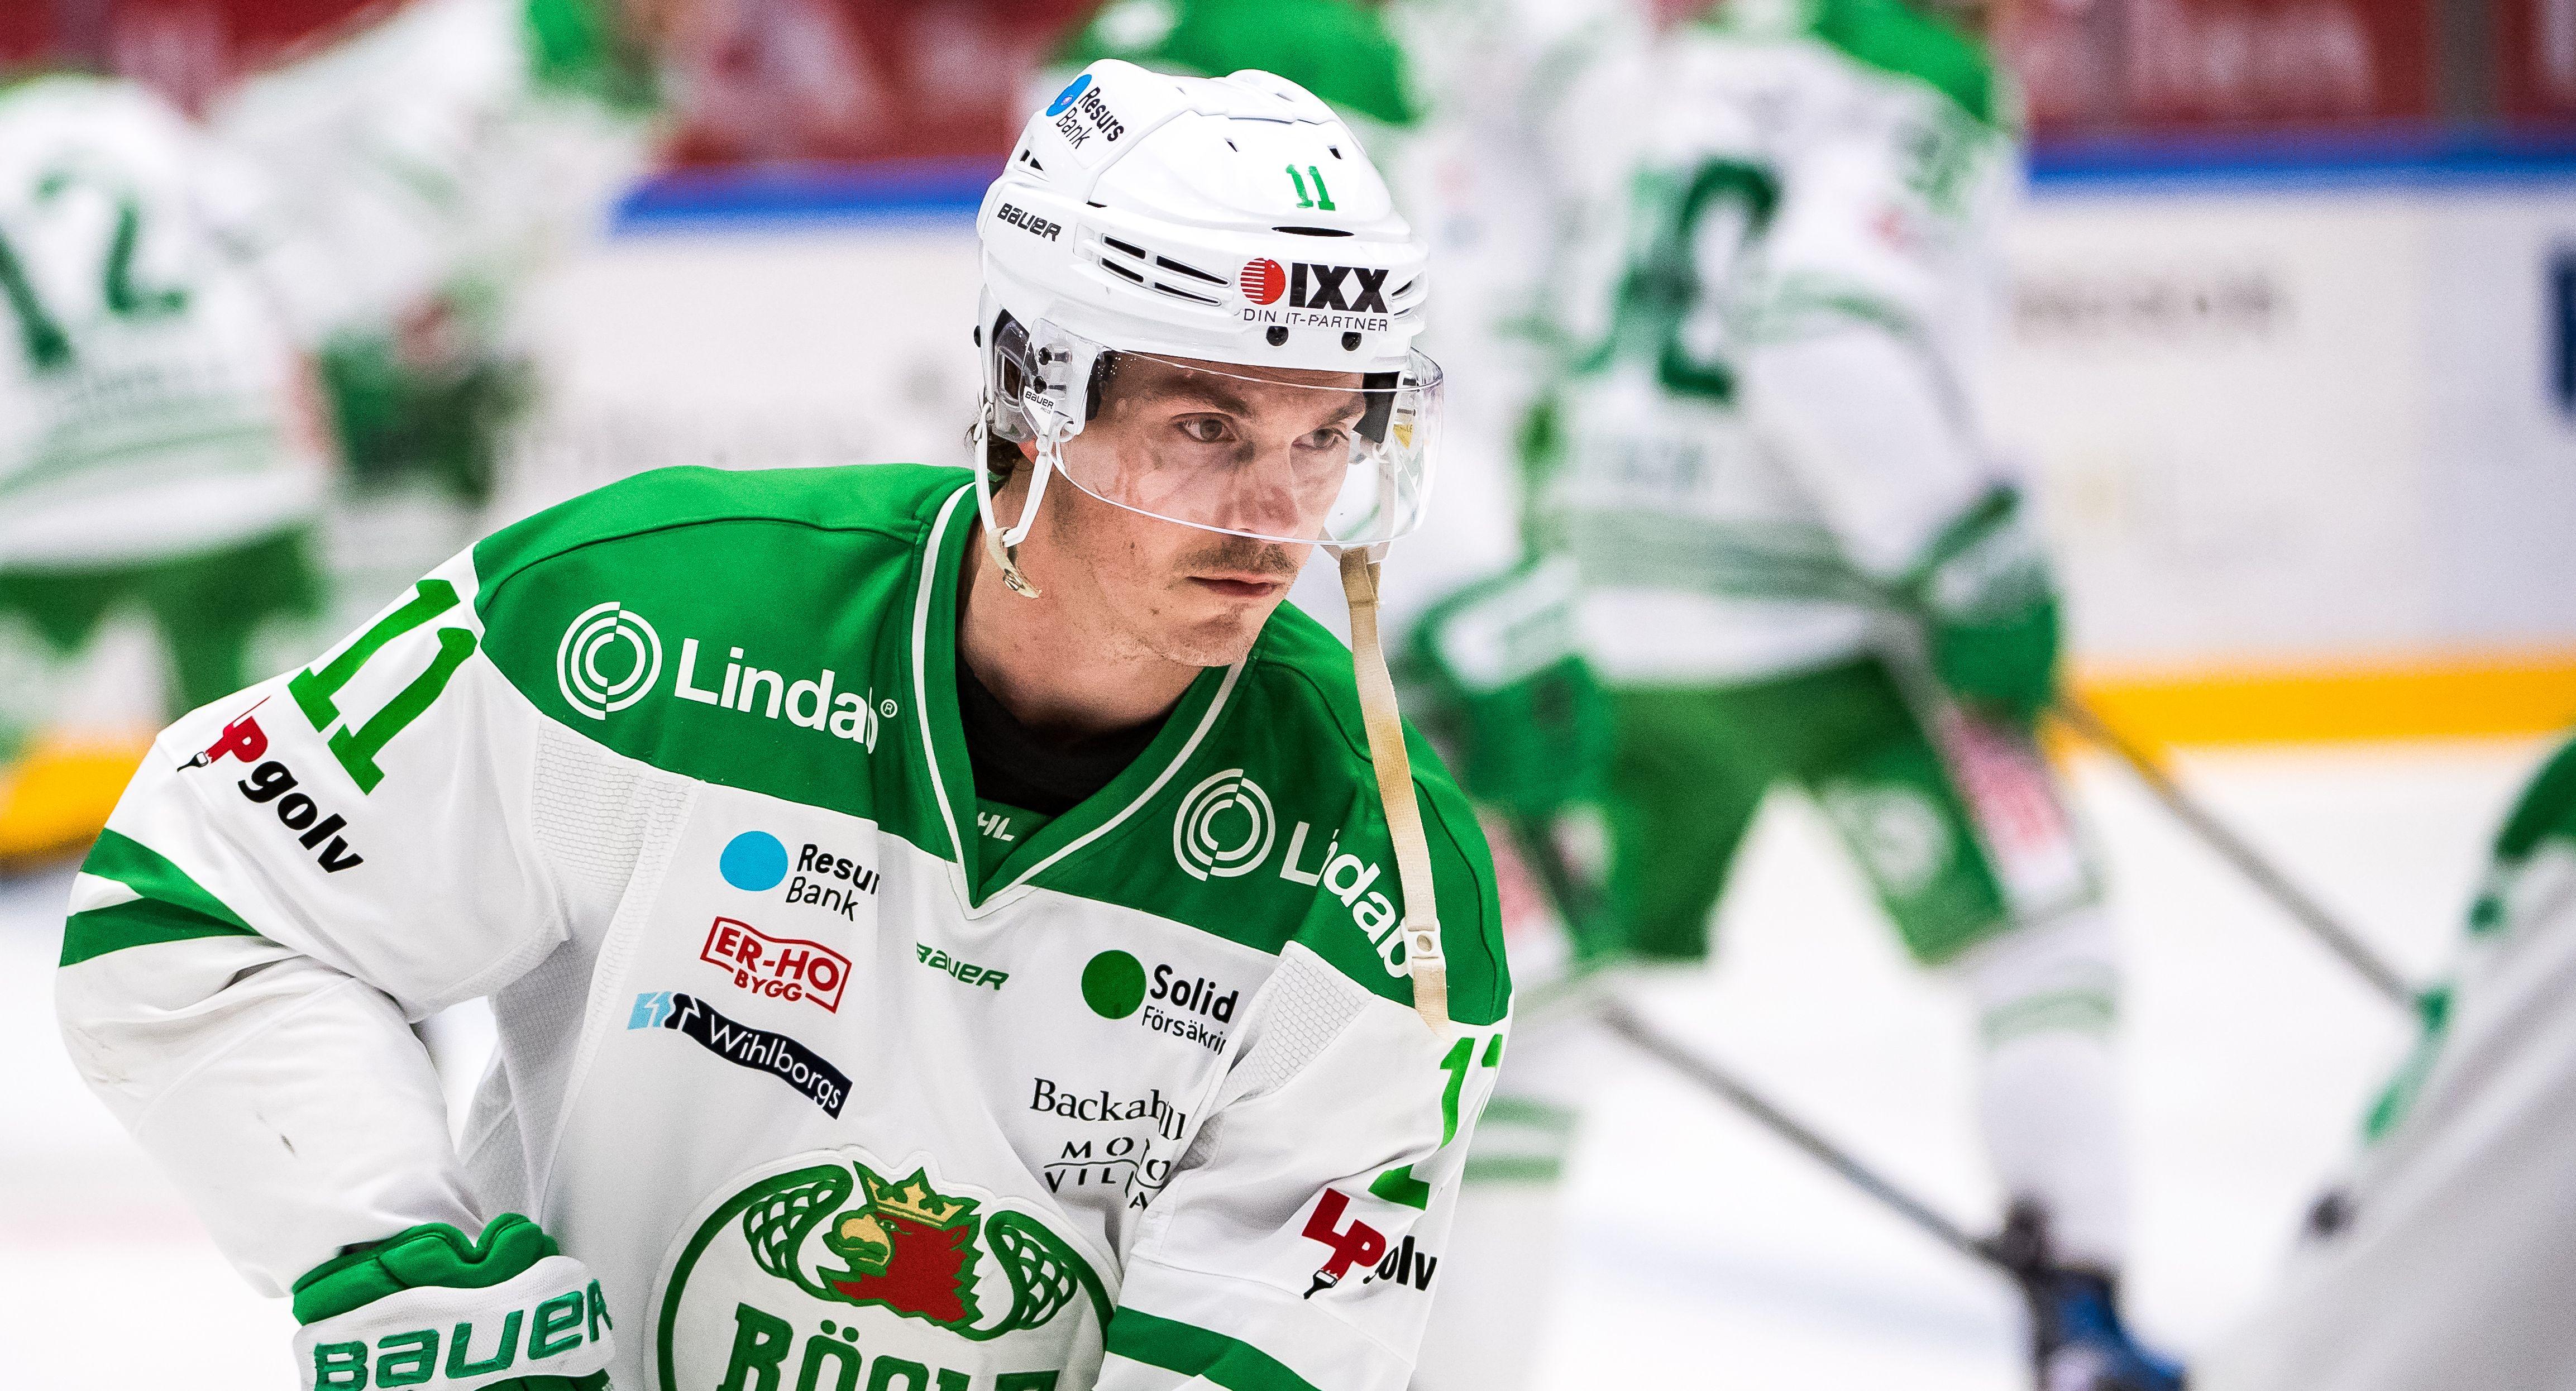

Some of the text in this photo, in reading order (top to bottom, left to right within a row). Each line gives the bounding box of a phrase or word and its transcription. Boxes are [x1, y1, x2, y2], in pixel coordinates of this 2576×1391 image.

[1056, 107, 1092, 149] Bank
[1078, 87, 1124, 142] Resurs
[1285, 164, 1336, 211] 11
[1289, 262, 1389, 313] IXX
[1244, 308, 1388, 332] DIN IT-PARTNER
[288, 579, 477, 796] 11
[206, 696, 364, 873] P golv
[797, 844, 880, 895] Resur
[786, 876, 858, 921] Bank
[715, 926, 839, 992] ER-HO
[734, 968, 802, 1001] BYGG
[1150, 964, 1239, 1024] Solid
[1142, 1005, 1226, 1055] Försäkri
[711, 1014, 841, 1108] Wihlborgs
[1363, 1235, 1437, 1291] olv
